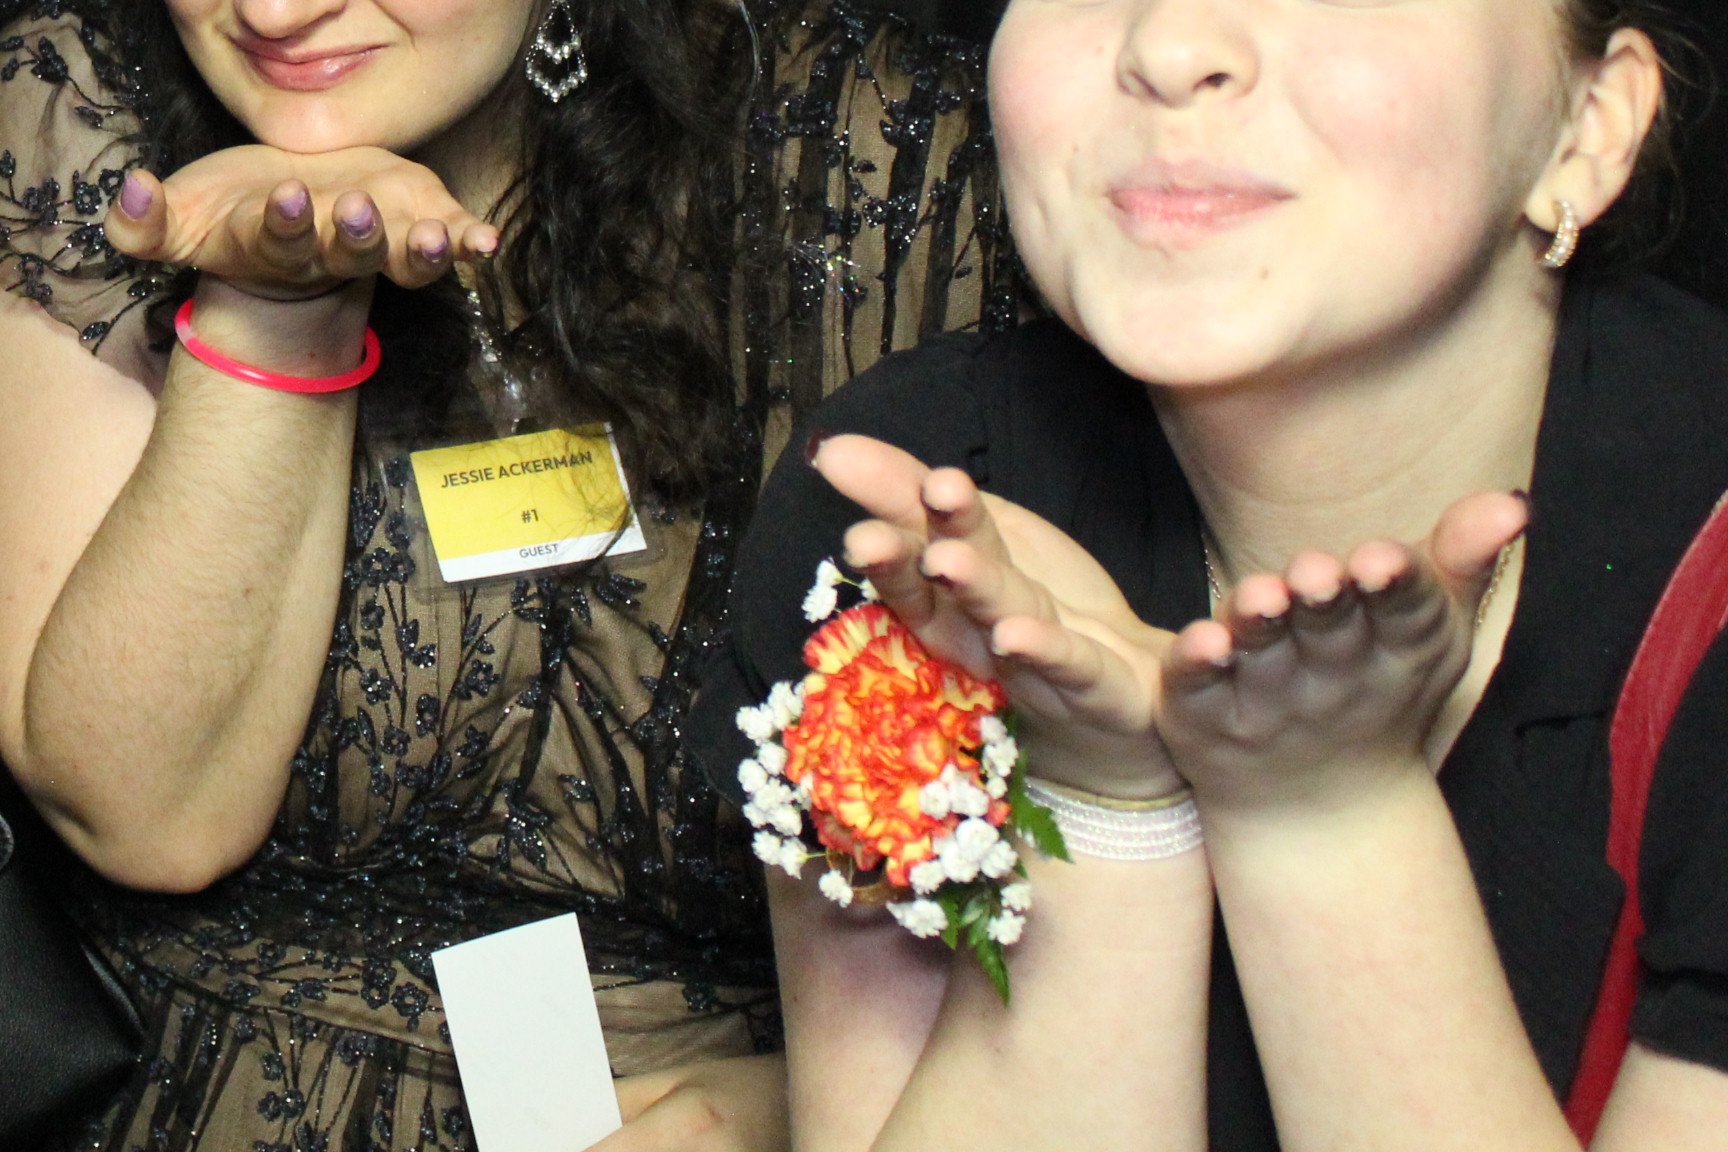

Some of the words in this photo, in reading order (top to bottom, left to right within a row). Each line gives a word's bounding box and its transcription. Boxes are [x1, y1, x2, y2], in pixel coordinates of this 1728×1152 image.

[441, 467, 495, 489] JESSIE
[498, 451, 593, 479] ACKERMAN
[521, 509, 539, 523] #1
[519, 543, 559, 559] GUEST
